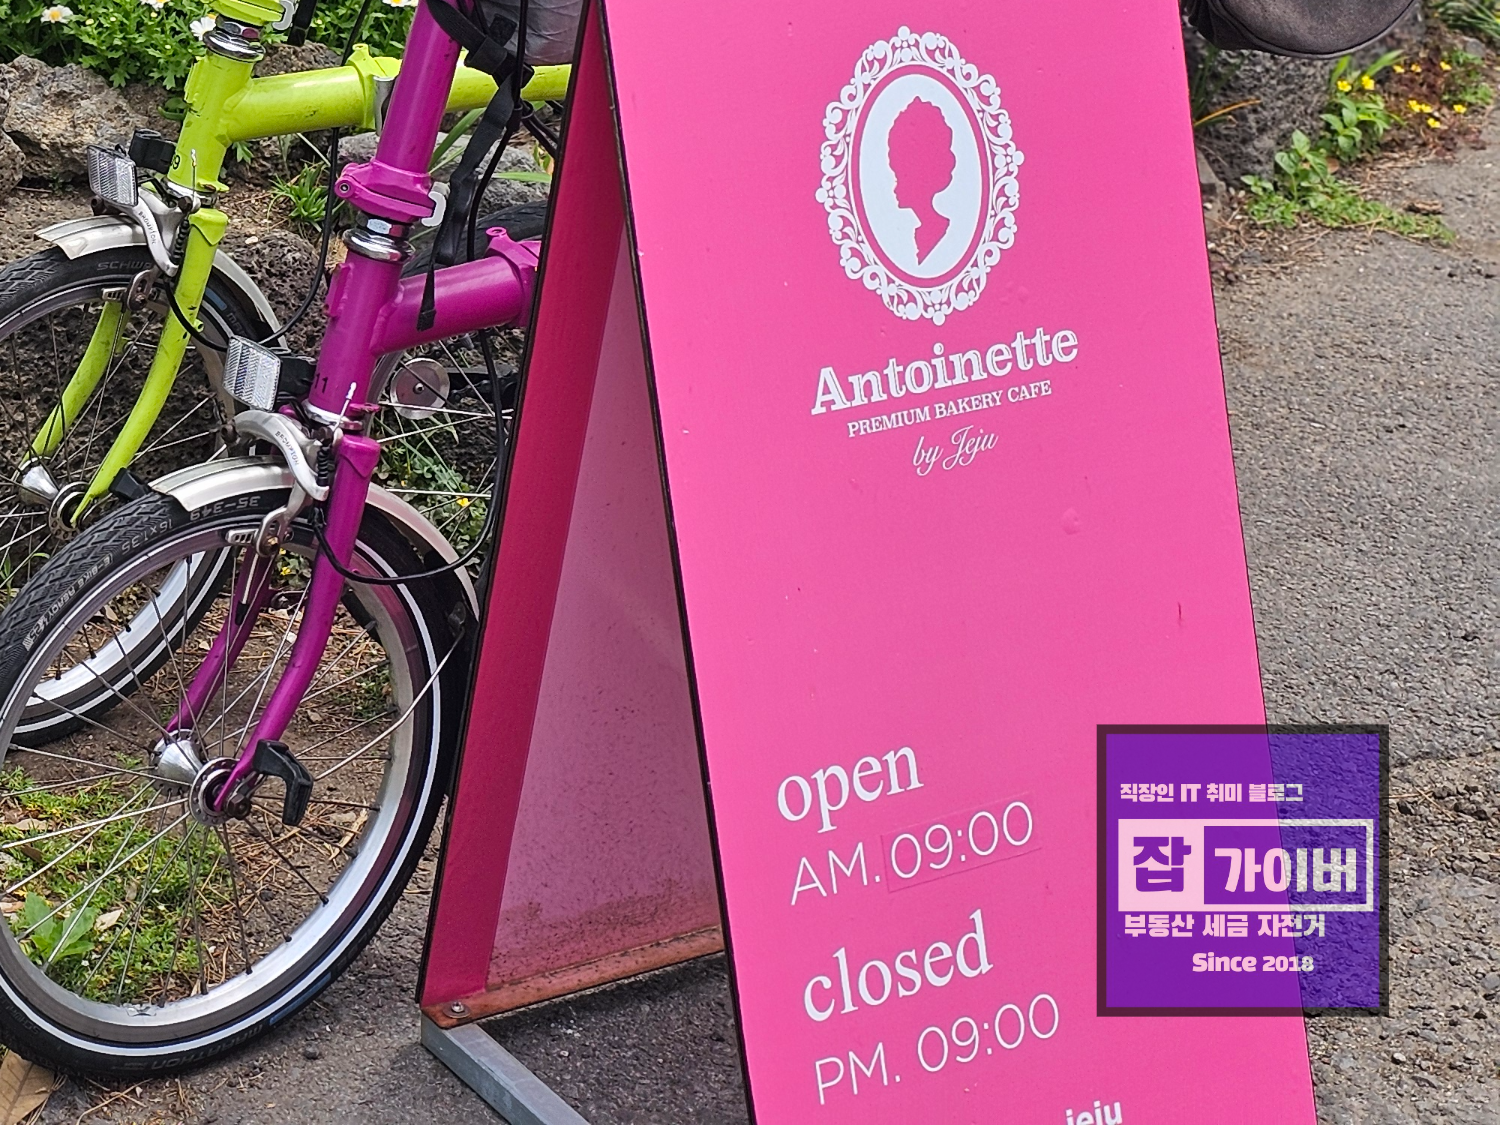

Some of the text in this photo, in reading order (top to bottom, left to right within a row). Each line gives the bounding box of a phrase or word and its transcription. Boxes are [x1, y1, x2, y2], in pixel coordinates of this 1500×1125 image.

[811, 327, 1079, 415] Antoinette
[847, 379, 1052, 437] PREMIUM BAKERY CAFE
[912, 424, 999, 476] by Jeju
[190, 495, 261, 521] 35-349
[777, 746, 924, 833] open
[803, 909, 994, 1022] closed
[815, 993, 1060, 1105] PM. 09:00
